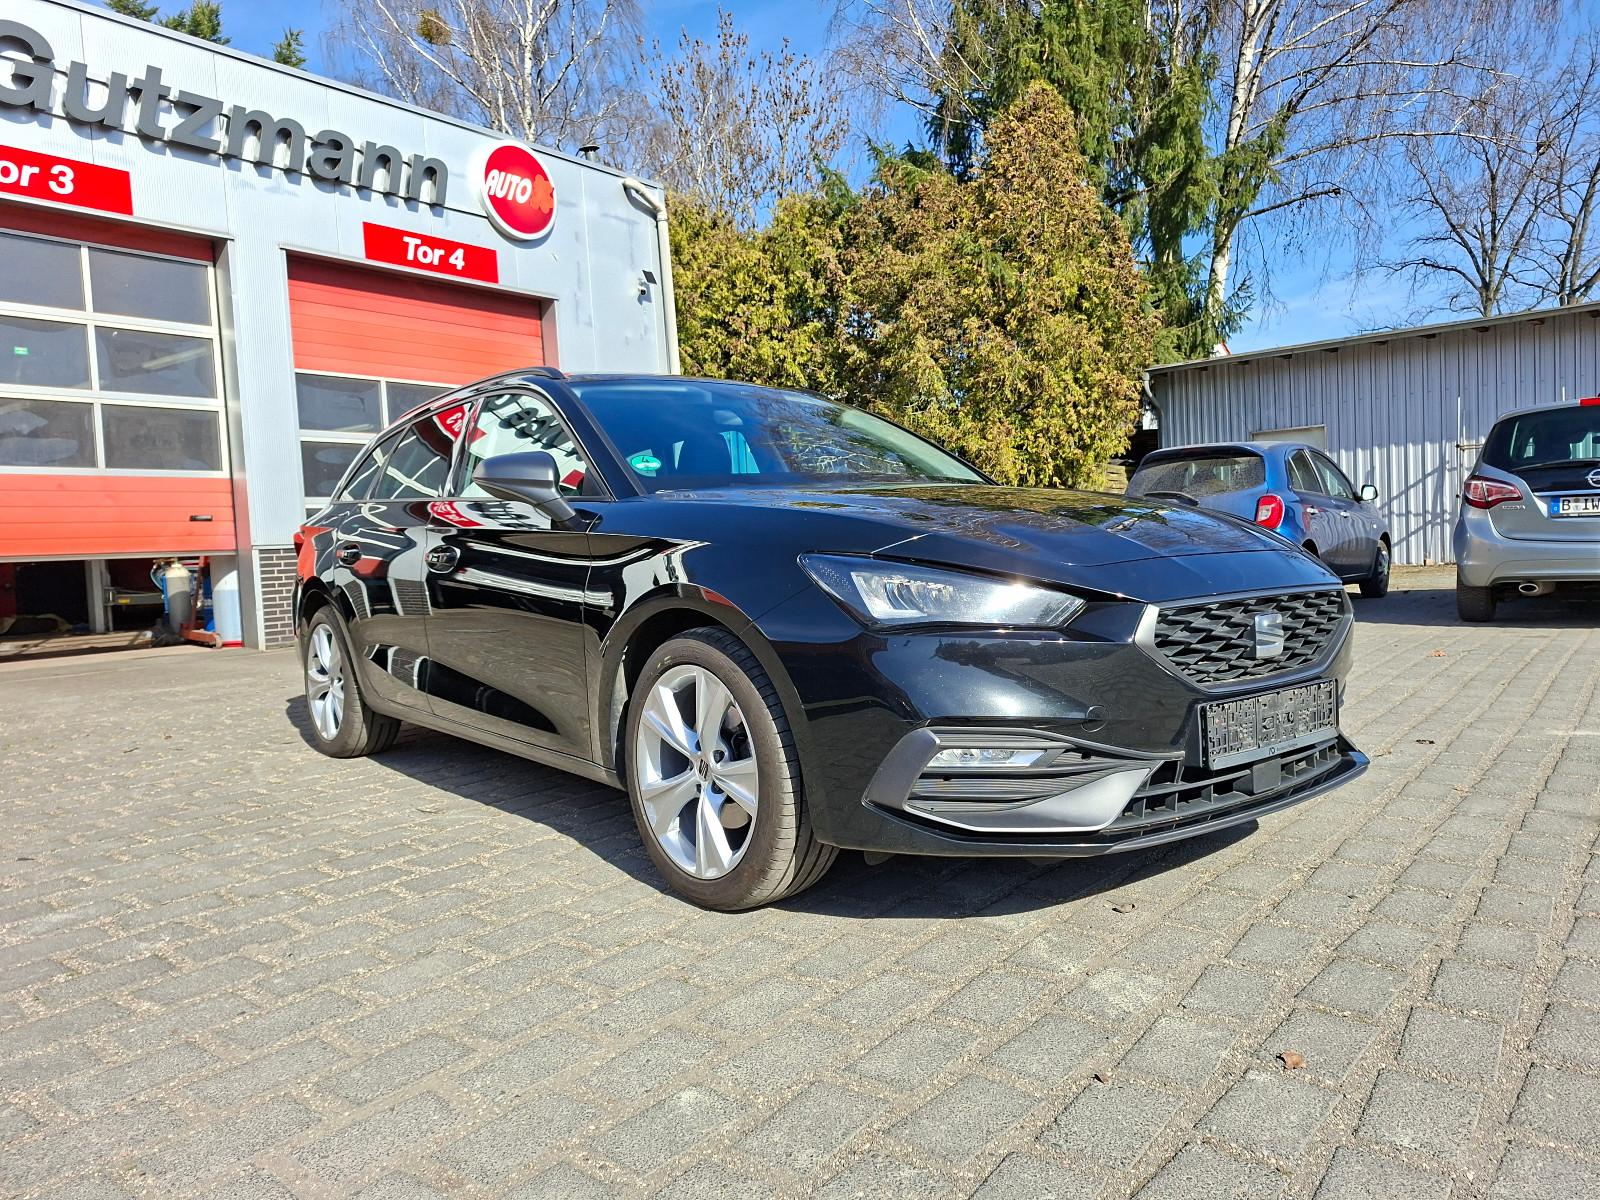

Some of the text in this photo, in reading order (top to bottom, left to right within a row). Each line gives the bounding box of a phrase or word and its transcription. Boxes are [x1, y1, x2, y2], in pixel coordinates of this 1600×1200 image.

[0, 19, 449, 205] Gutzmann
[0, 159, 75, 195] or 3
[485, 169, 532, 204] AUTO
[403, 235, 465, 270] Tor 4
[1562, 499, 1571, 511] B
